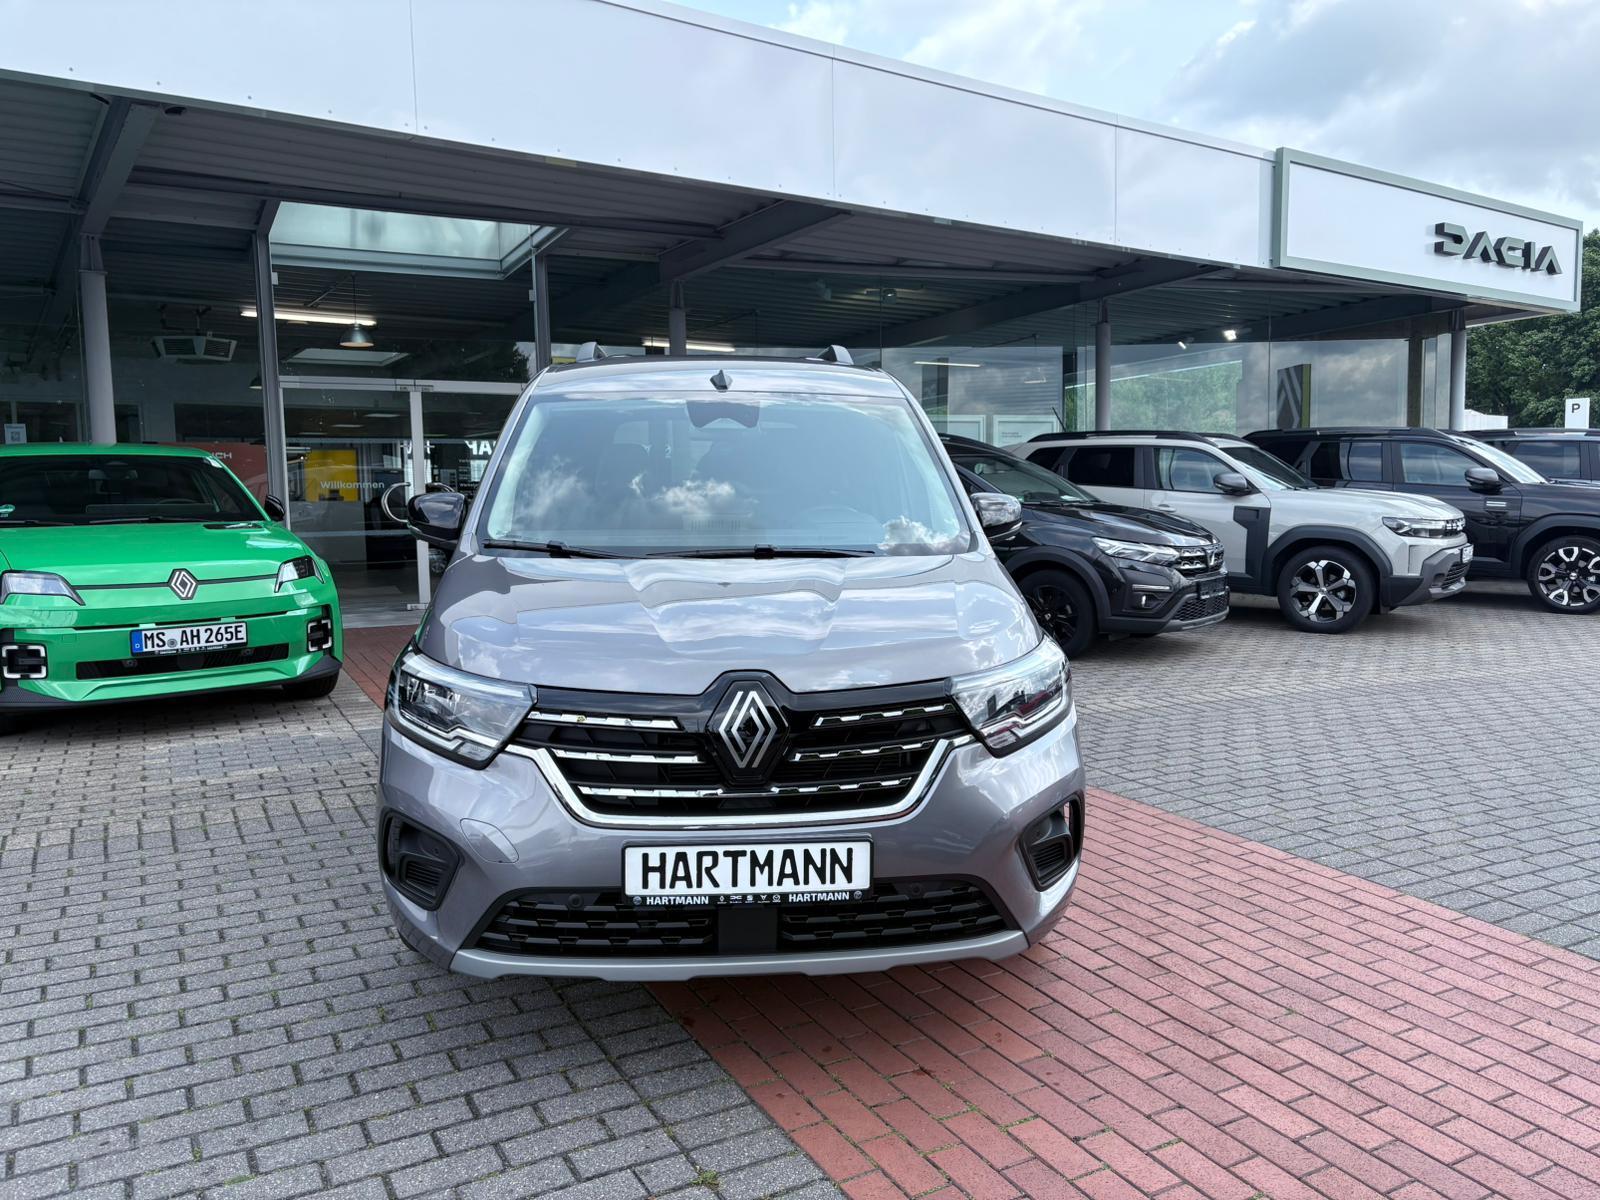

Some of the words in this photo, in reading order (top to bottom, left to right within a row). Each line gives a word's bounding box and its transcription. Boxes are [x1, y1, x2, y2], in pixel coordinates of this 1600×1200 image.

[1434, 222, 1562, 275] DACIA
[1571, 403, 1581, 414] P
[319, 480, 385, 490] Willkommen
[143, 631, 167, 650] MS
[179, 628, 201, 647] AH
[203, 624, 245, 645] 265E
[641, 846, 854, 890] HARTMANN
[646, 895, 710, 906] HARTMANN
[787, 891, 850, 903] HARTMANN
